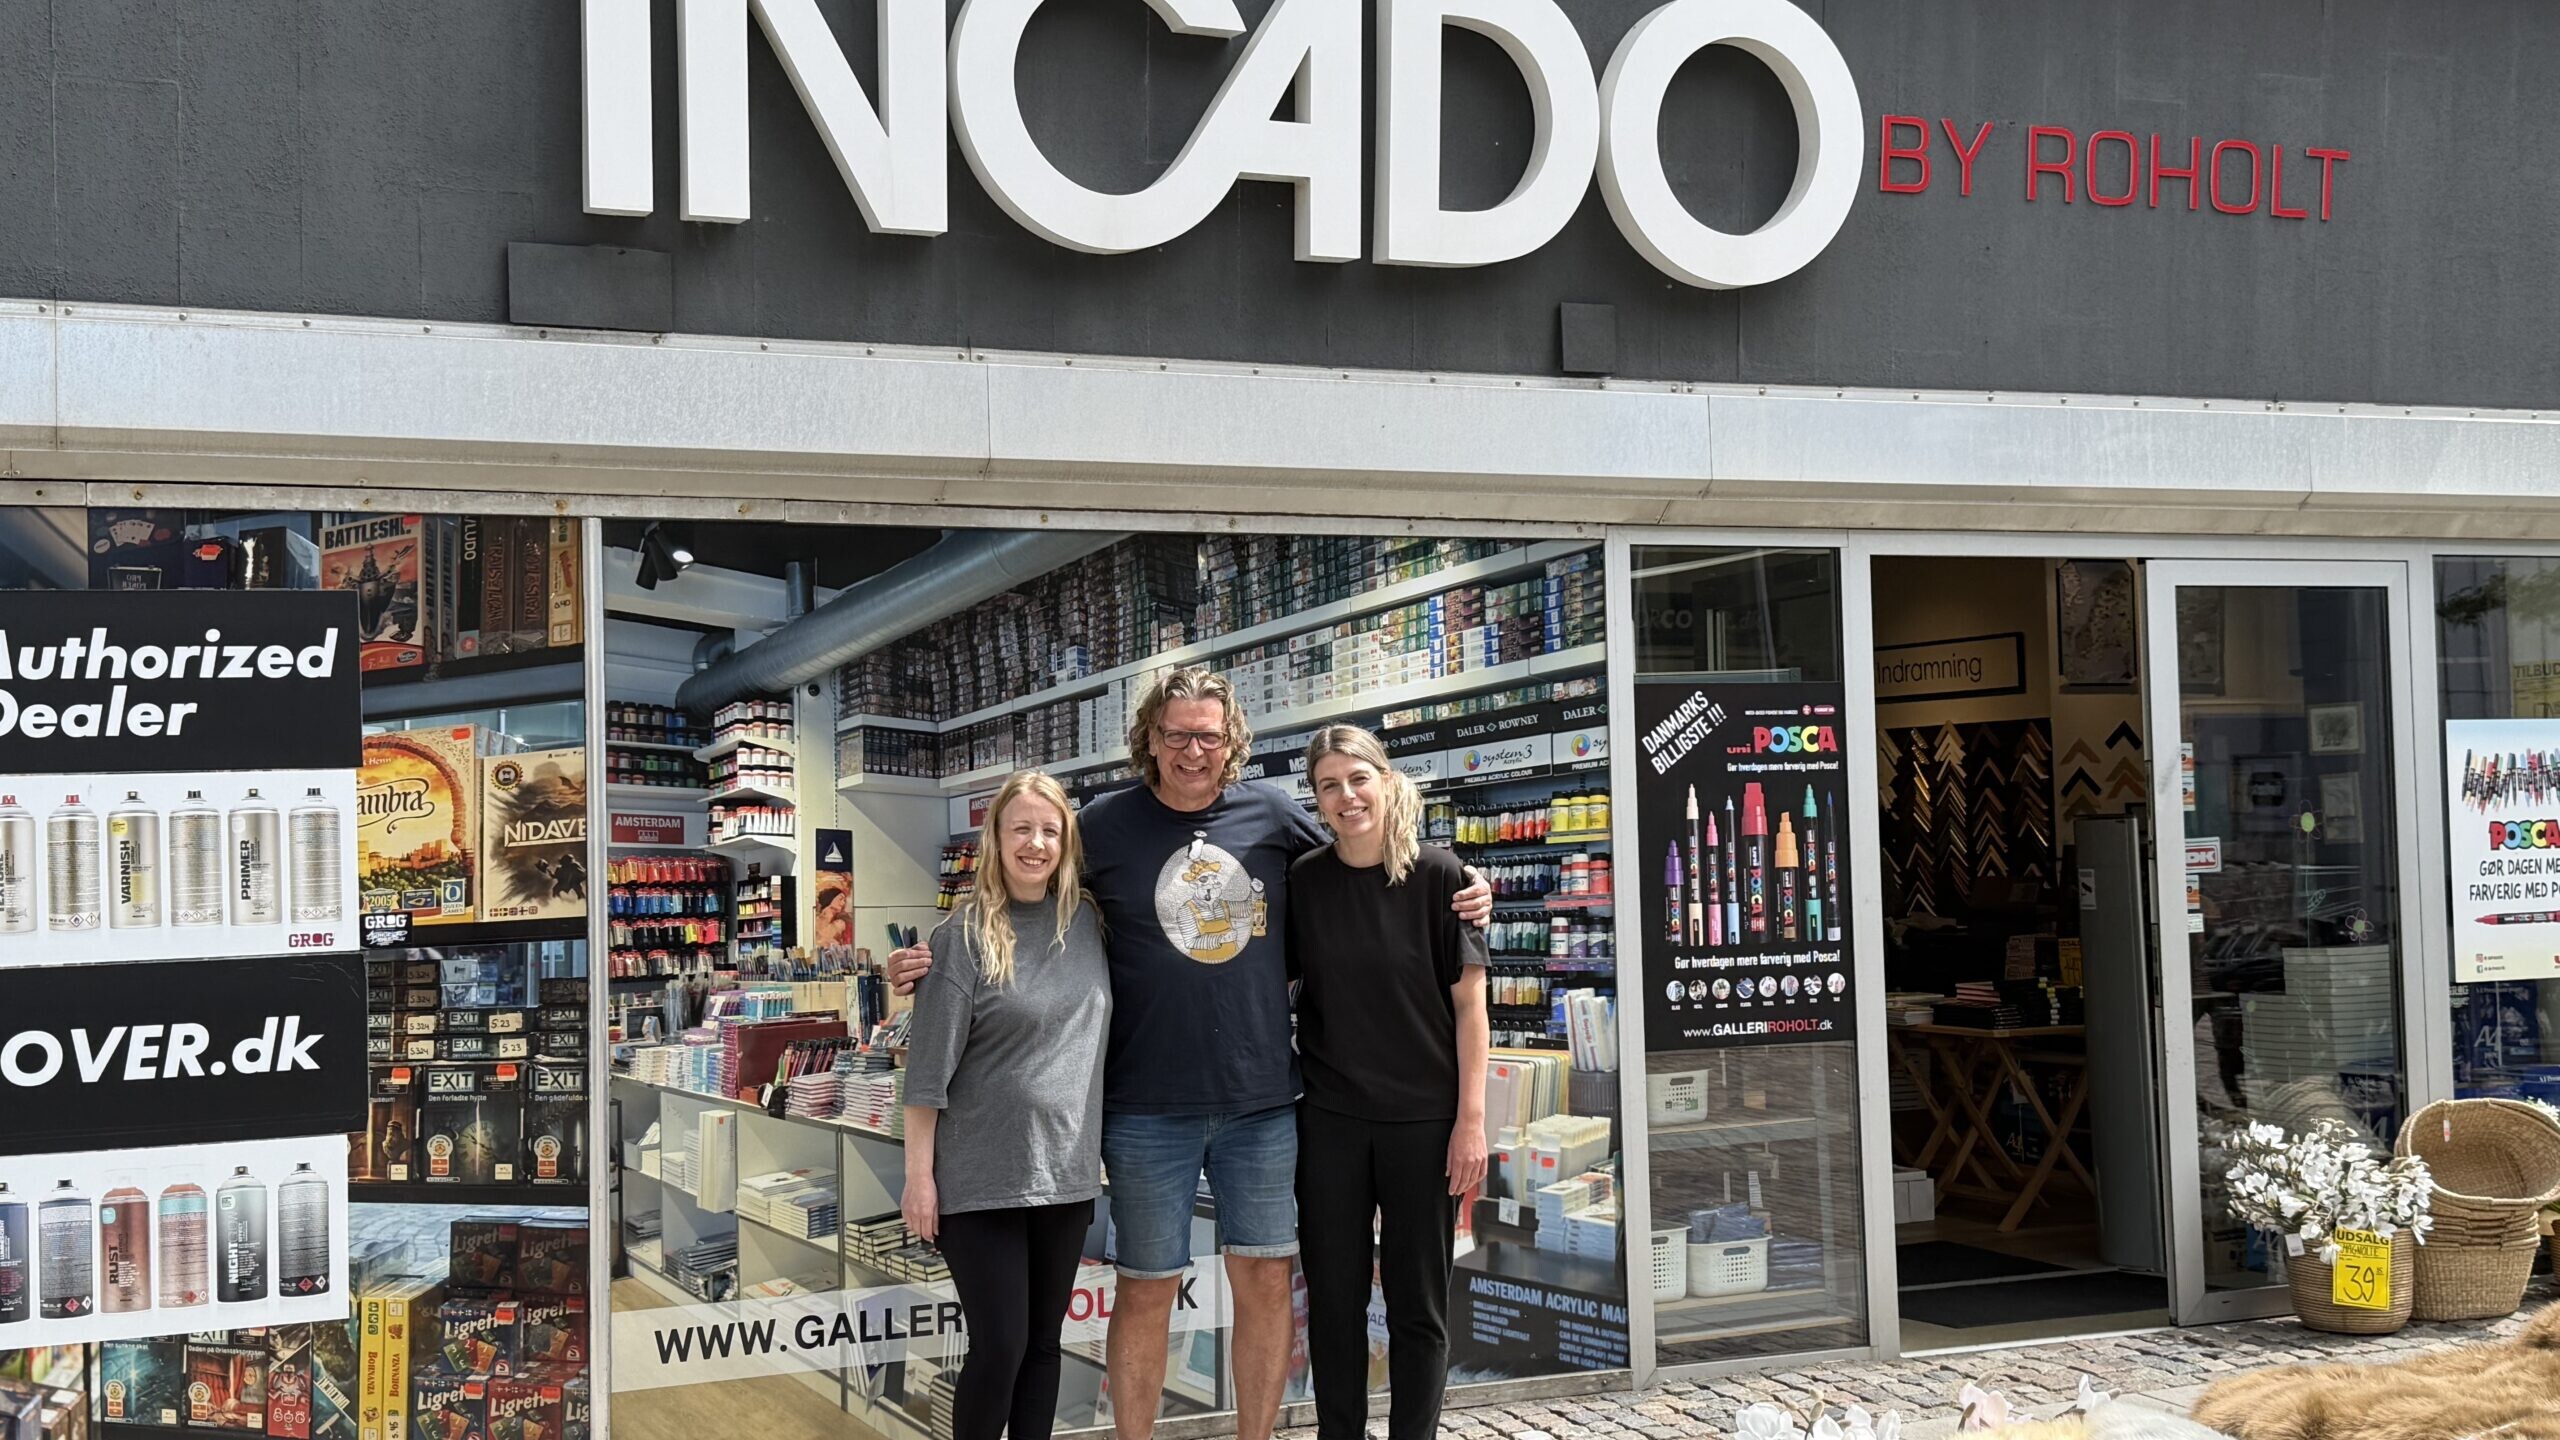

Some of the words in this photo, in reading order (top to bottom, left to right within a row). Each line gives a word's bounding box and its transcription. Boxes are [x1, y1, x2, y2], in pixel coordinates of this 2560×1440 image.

[583, 0, 1864, 289] INCADO
[1880, 115, 1994, 196] BY
[2026, 125, 2350, 222] ROHOLT
[1877, 652, 1981, 684] Indramning
[1563, 706, 1596, 720] DALER
[1642, 691, 1709, 754] DANMARKS
[1457, 725, 1486, 737] DALER
[1499, 714, 1539, 730] ROWNEY
[1401, 731, 1436, 747] ROWNEY
[1651, 716, 1712, 775] BILLIGSTE
[1753, 725, 1838, 753] POSCA
[615, 816, 680, 828] AMSTERDAM
[2489, 819, 2560, 850] POSCA
[120, 840, 132, 904] VARNISH
[240, 840, 251, 900] PRIMER
[2479, 859, 2504, 876] GØR
[2508, 858, 2541, 875] DAGEN
[369, 896, 392, 907] 2005
[1750, 868, 1763, 914] POSCA
[2469, 883, 2521, 901] FARVERIG
[2525, 882, 2548, 898] MED
[1784, 888, 1794, 925] POSCA
[1691, 956, 1734, 970] hverdagen
[1737, 956, 1758, 967] mere
[1760, 952, 1791, 967] farverig
[1793, 951, 1811, 963] med
[1813, 949, 1841, 962] Posca!
[450, 1012, 478, 1023] EXIT
[1683, 1018, 1833, 1037] www.GALLERIROHOLT.dk
[0, 1015, 324, 1087] OVER.dk
[453, 1039, 481, 1049] EXIT
[551, 1034, 579, 1044] EXIT
[431, 1074, 472, 1090] EXIT
[538, 1072, 579, 1089] EXIT
[2336, 1230, 2389, 1245] UDSALG
[109, 1244, 119, 1284] RUST
[1469, 1277, 1542, 1307] AMSTERDAM
[1545, 1292, 1597, 1318] ACRYLIC
[445, 1312, 497, 1339] Ligrett
[490, 1391, 545, 1417] Ligrett
